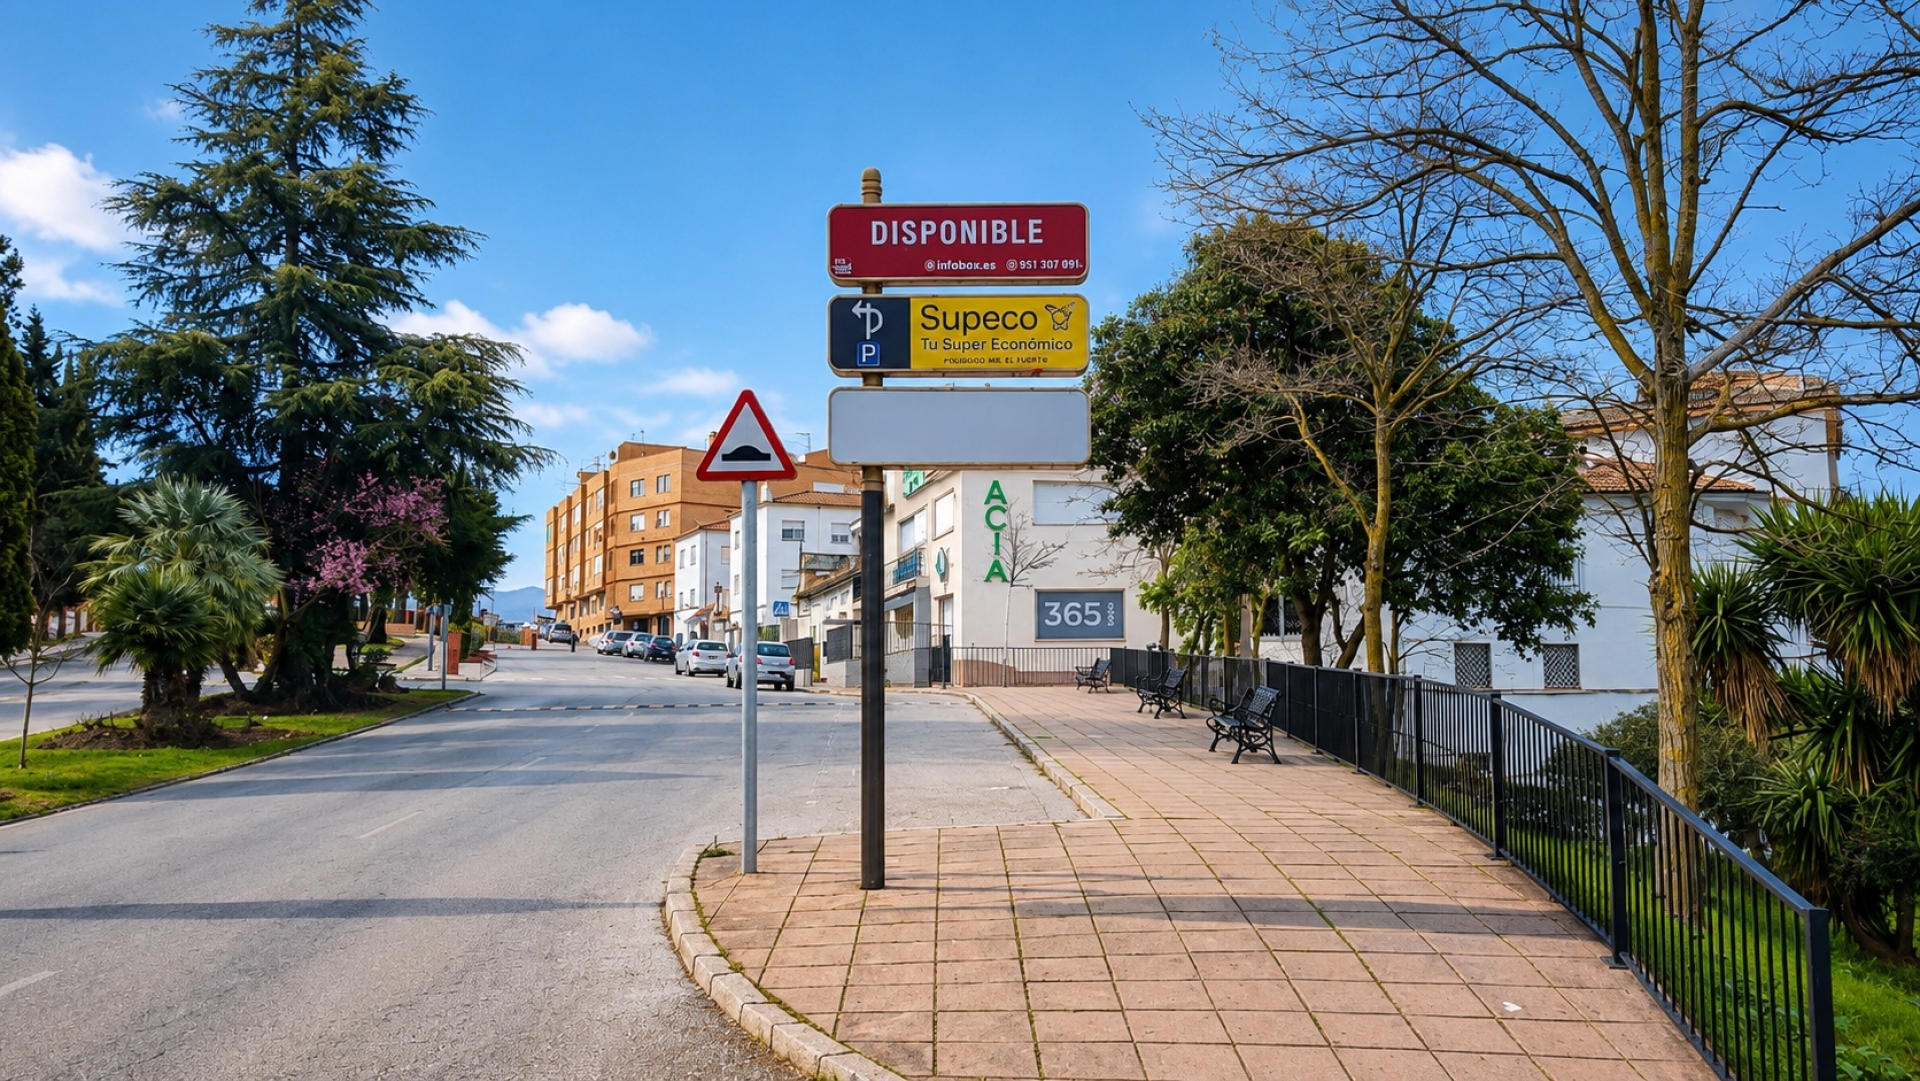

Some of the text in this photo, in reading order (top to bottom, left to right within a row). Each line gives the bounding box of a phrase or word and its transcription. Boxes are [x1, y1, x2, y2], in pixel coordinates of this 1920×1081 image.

[871, 219, 1043, 245] DISPONIBLE
[937, 260, 996, 270] infobox.es
[1040, 259, 1058, 269] 307
[920, 304, 1038, 336] Supeco
[862, 344, 876, 363] P
[920, 337, 1073, 353] Tu Super Económico
[984, 480, 1009, 583] ACIA
[1044, 601, 1102, 627] 365
